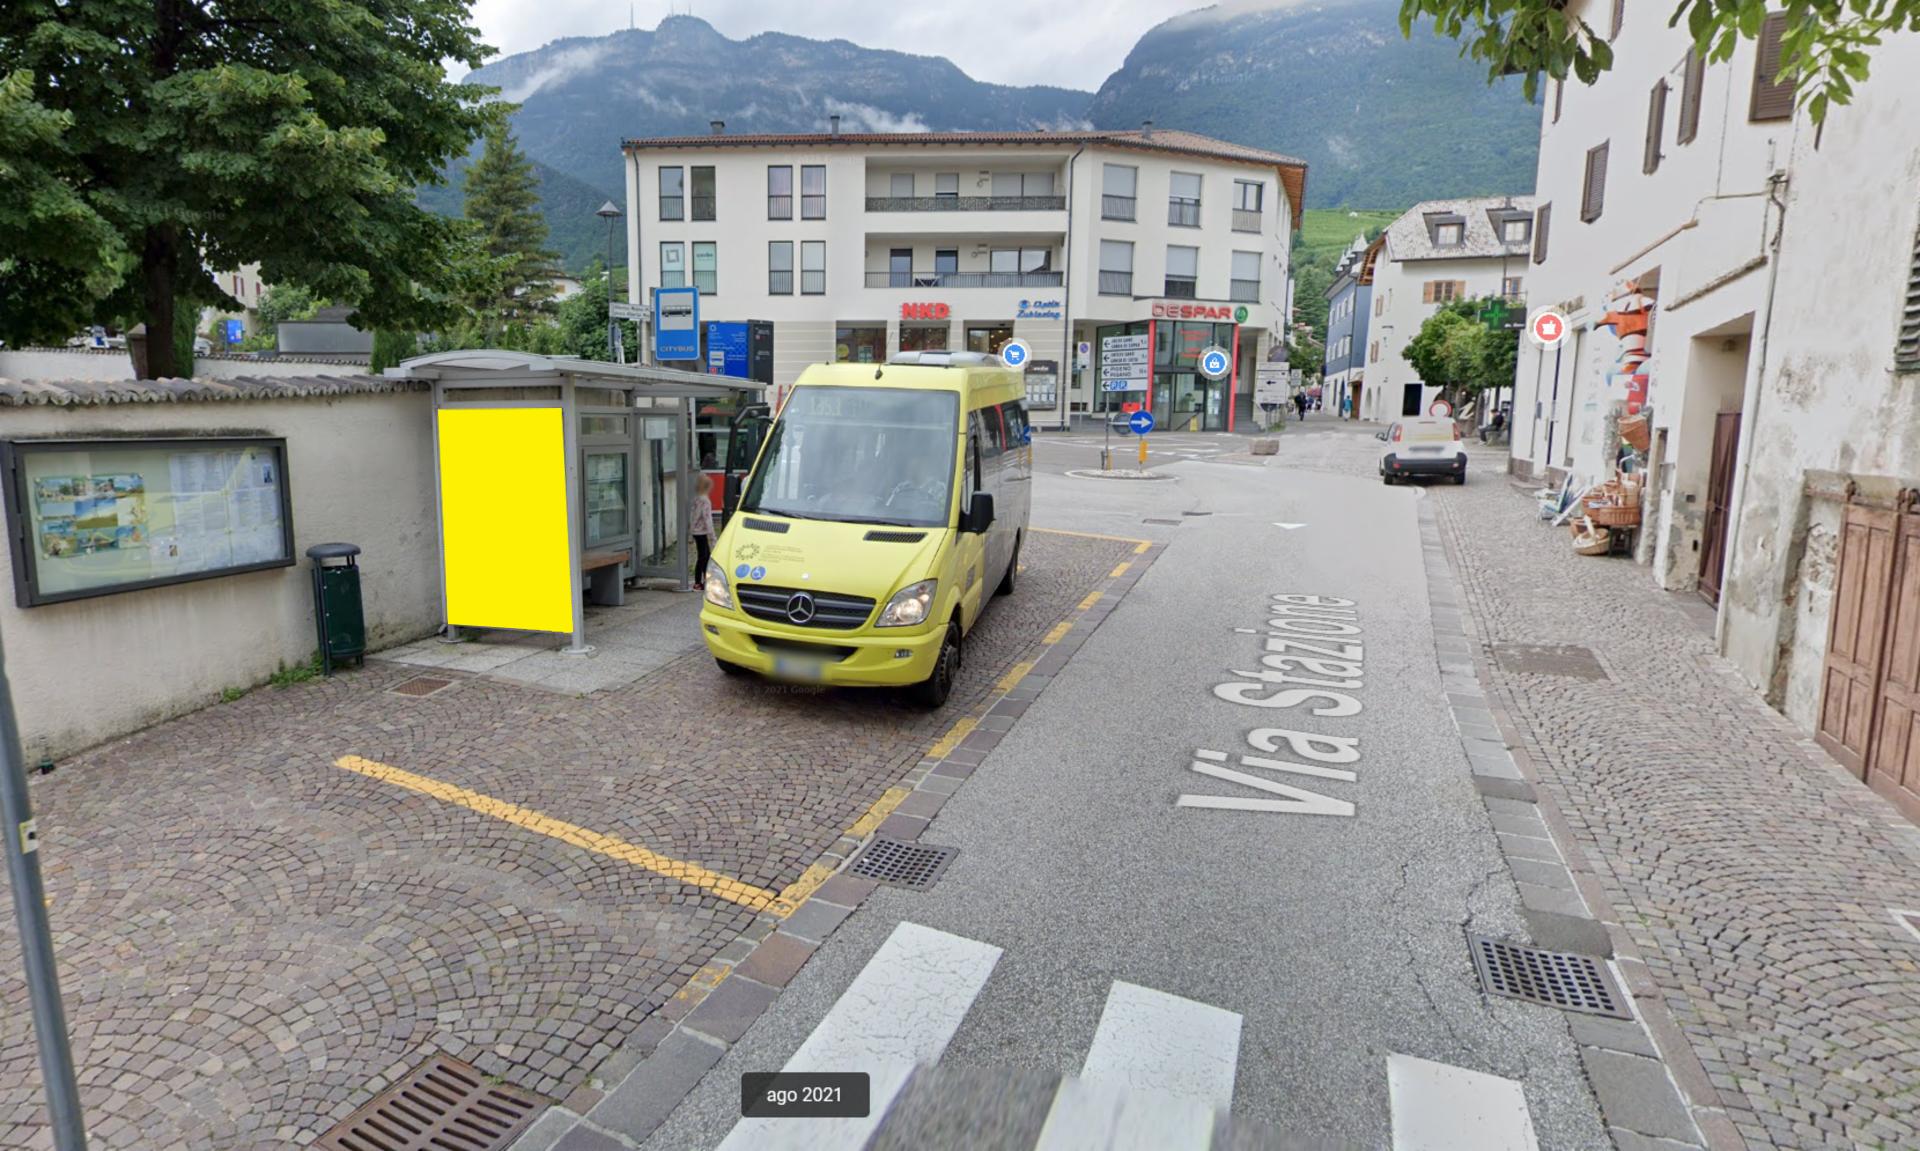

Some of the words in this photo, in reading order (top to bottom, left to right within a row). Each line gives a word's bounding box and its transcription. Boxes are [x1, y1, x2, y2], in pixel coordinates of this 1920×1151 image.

[901, 303, 951, 320] NKD
[1152, 303, 1232, 319] DESPAR
[659, 344, 695, 353] CITYBUS
[1213, 593, 1365, 717] Stazione
[1176, 728, 1361, 816] Via
